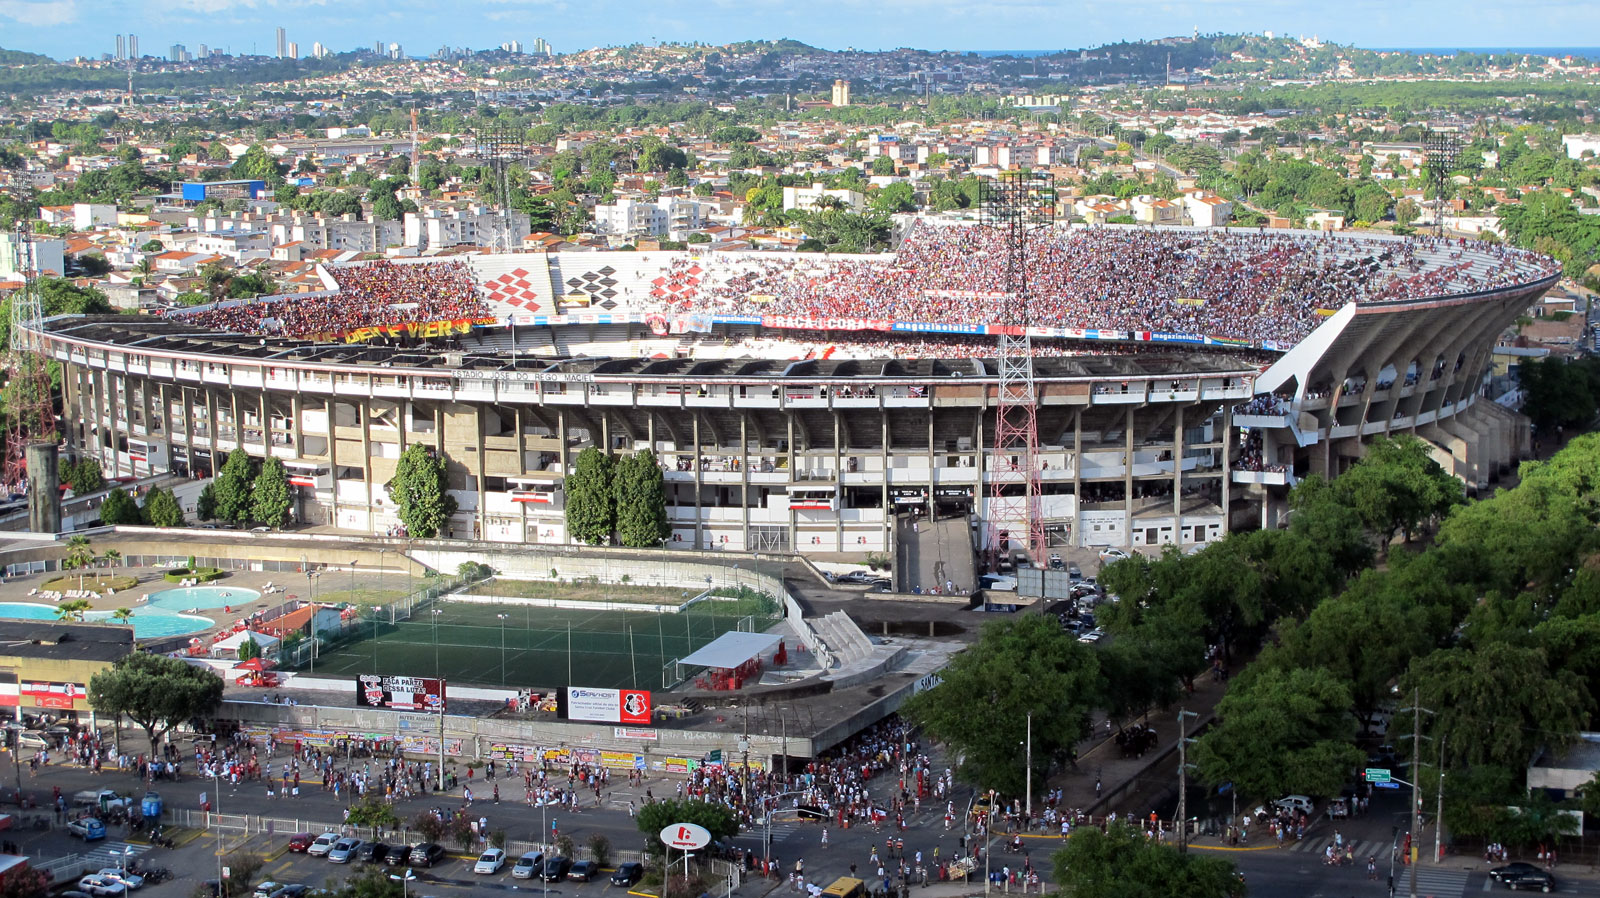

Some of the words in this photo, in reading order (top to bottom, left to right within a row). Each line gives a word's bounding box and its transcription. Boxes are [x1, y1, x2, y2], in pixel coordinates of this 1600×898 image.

[516, 372, 529, 381] DO
[564, 373, 594, 382] MACIEL
[401, 678, 424, 687] PARTE
